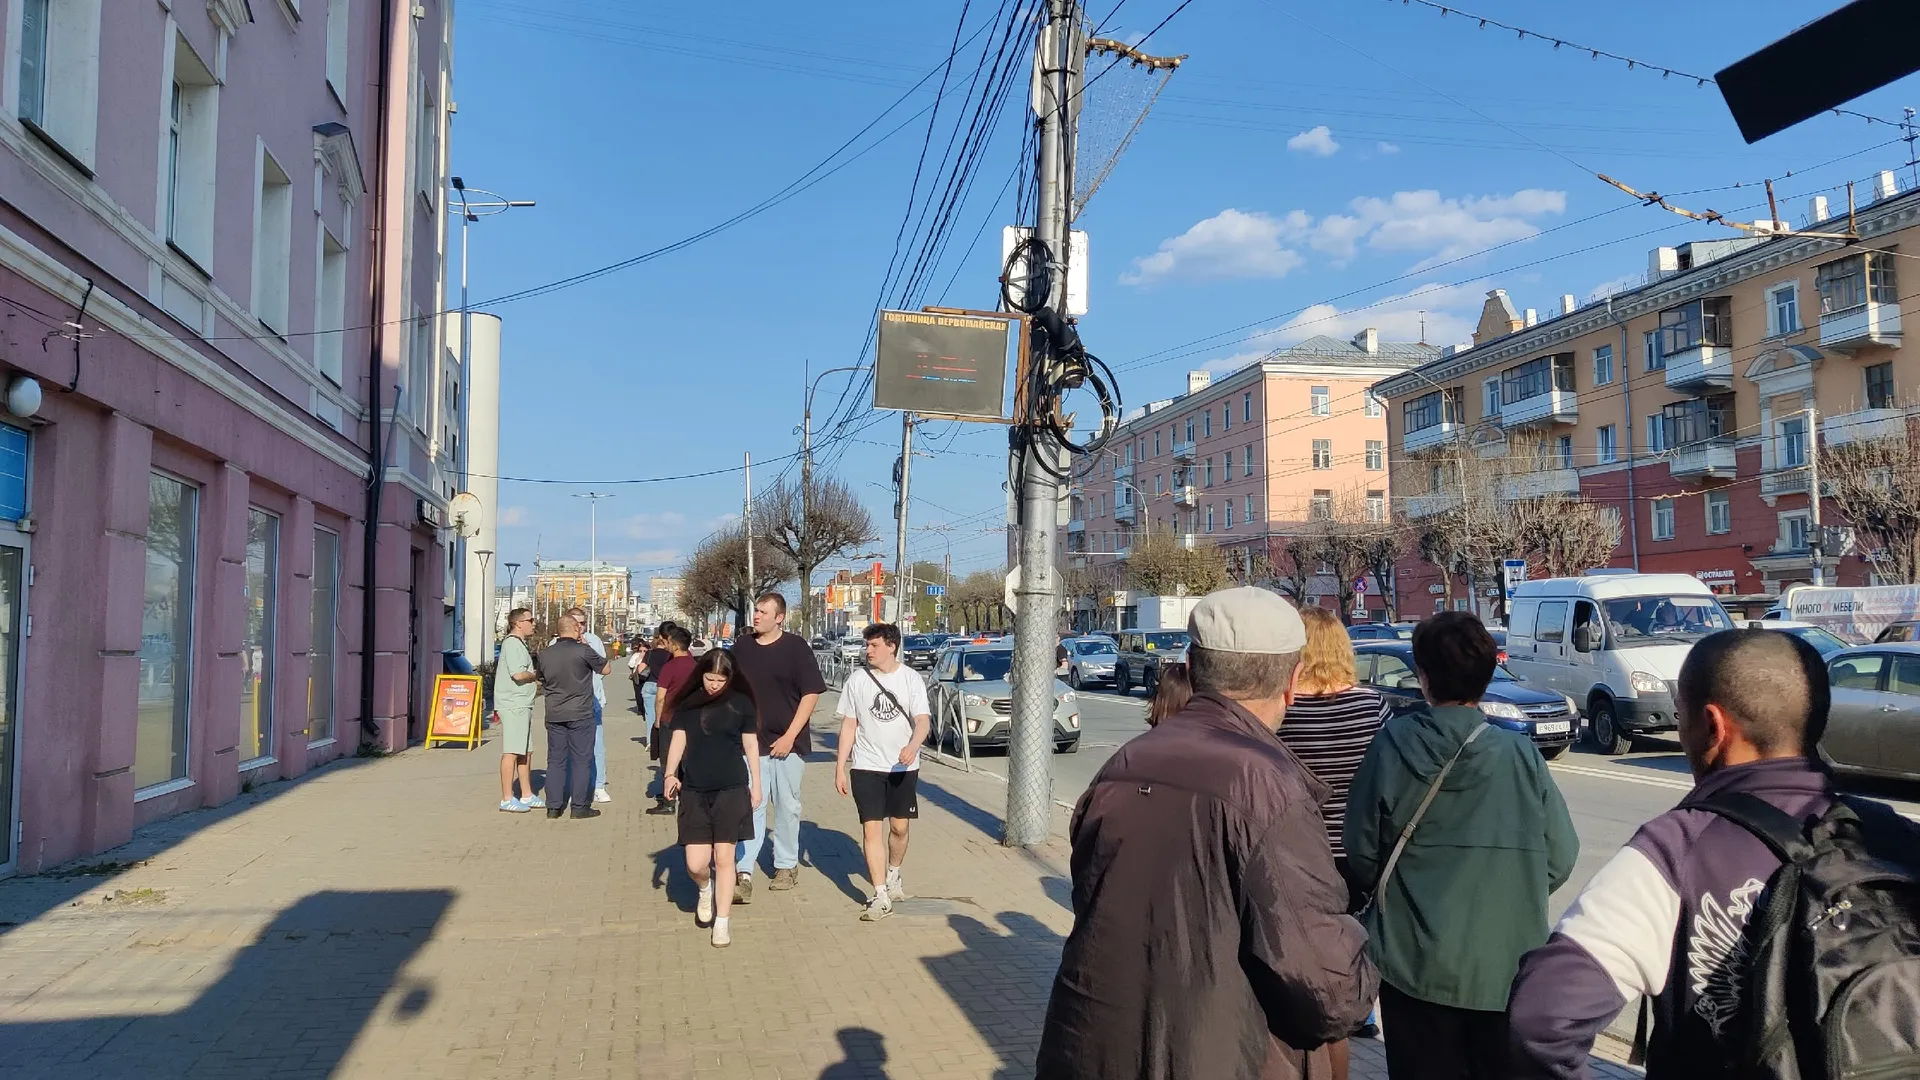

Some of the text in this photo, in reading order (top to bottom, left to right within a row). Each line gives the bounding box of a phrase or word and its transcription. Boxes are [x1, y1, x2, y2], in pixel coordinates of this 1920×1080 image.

[884, 312, 936, 325] ГОСТИНИЦА
[1796, 603, 1821, 614] МНОГО
[1833, 601, 1864, 612] МЕБЕЛИ
